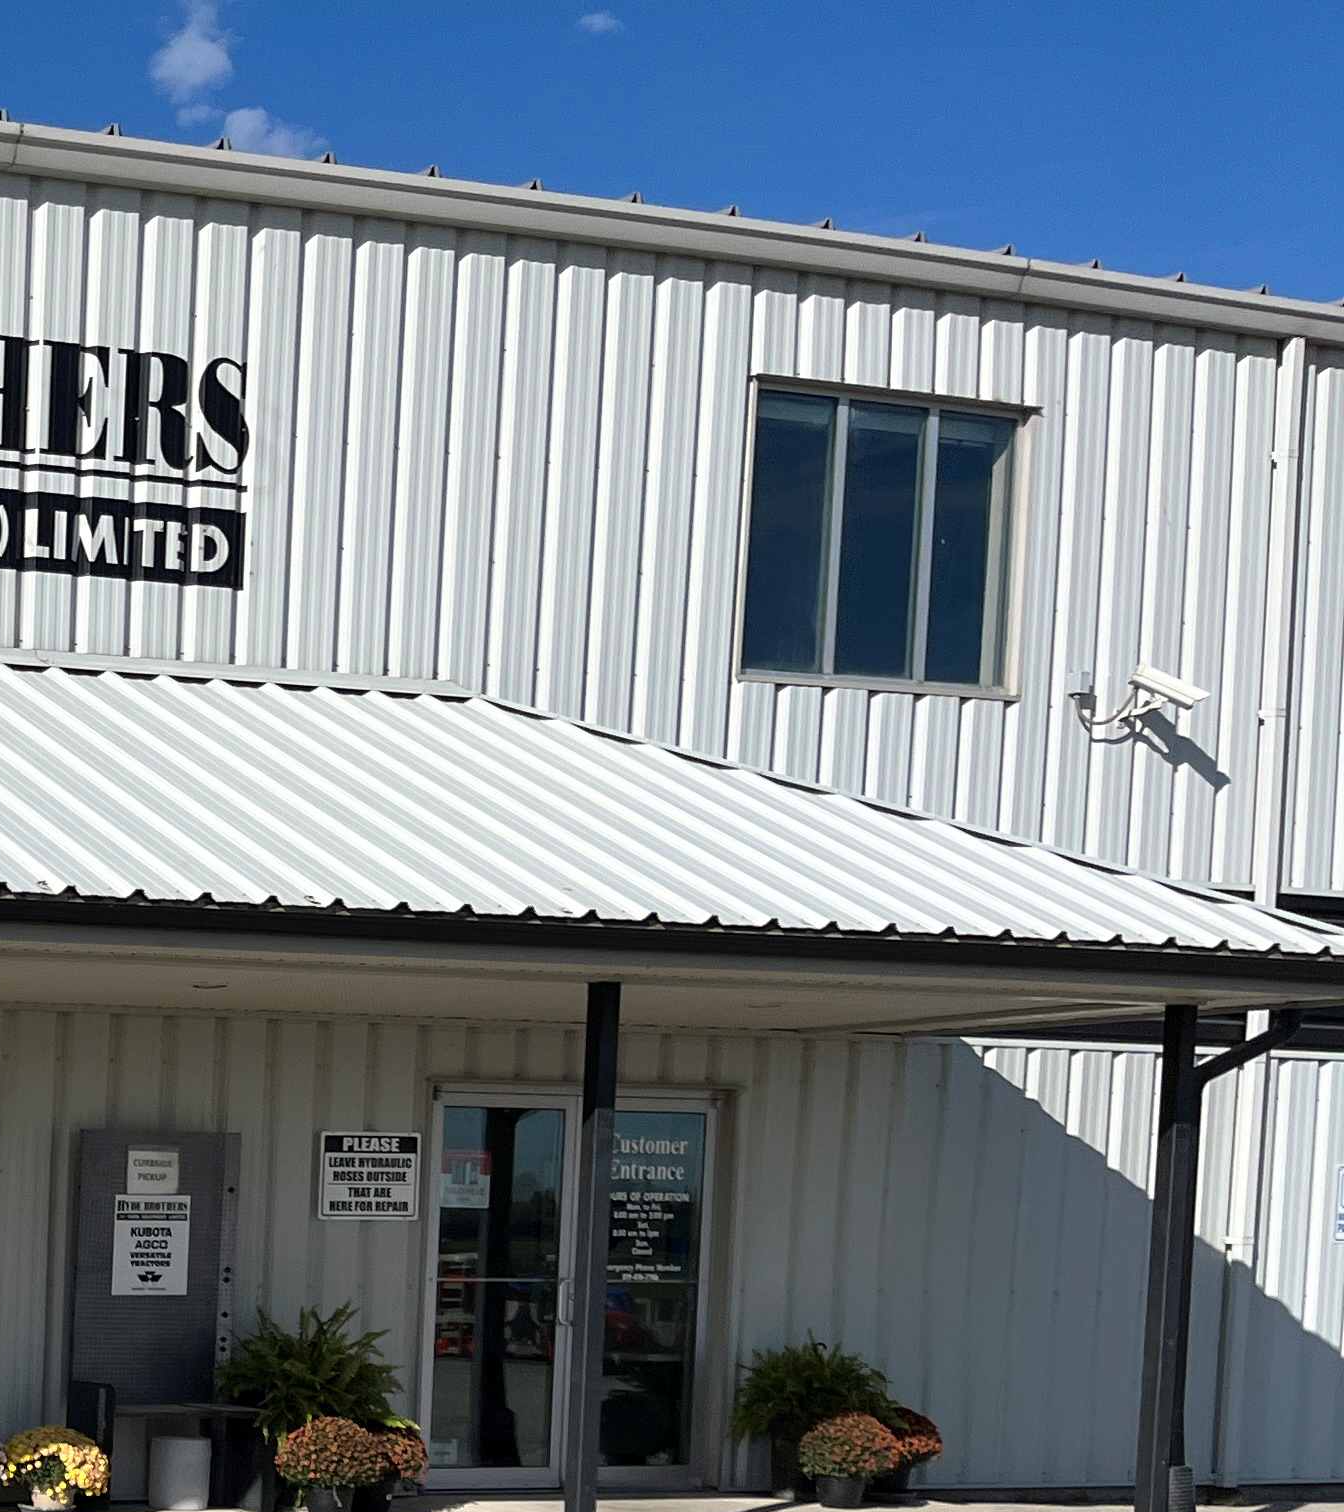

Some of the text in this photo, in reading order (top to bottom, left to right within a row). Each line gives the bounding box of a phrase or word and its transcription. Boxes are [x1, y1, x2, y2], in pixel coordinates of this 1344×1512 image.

[23, 503, 230, 575] LIMITED
[343, 1137, 401, 1152] PLEASE
[329, 1157, 412, 1169] LEAVE HYDRAULIC
[333, 1171, 408, 1182] HOSES OUTSIDE
[348, 1187, 392, 1198] THAT ARE
[329, 1201, 408, 1212] HERE FOR REPAIR
[130, 1227, 172, 1237] KUBOTA
[134, 1239, 169, 1250] AGCO
